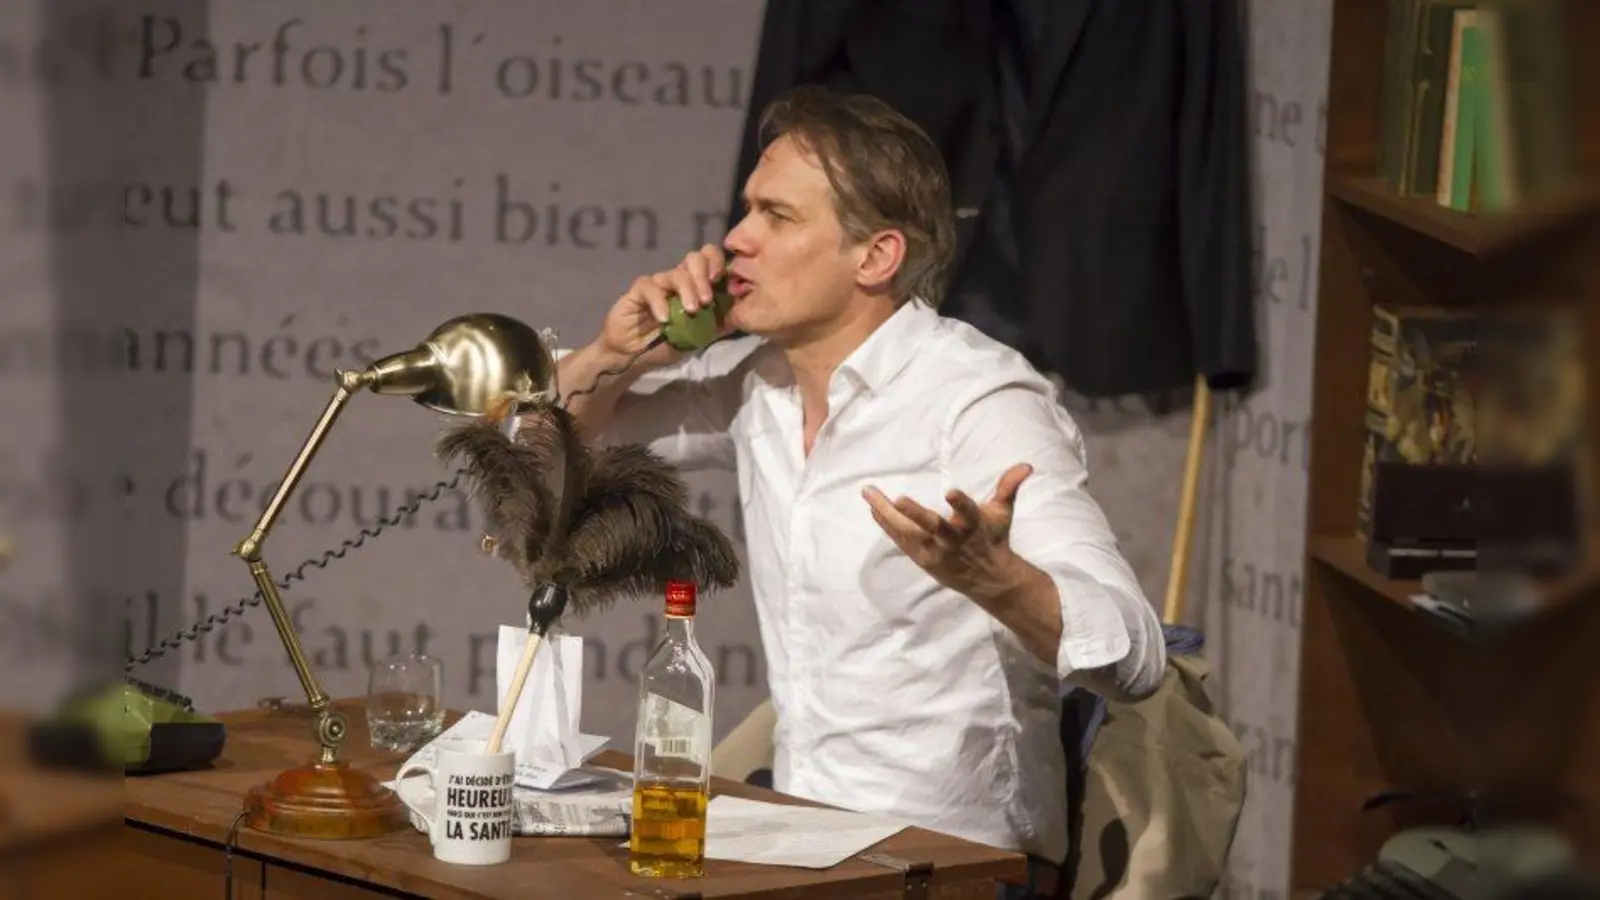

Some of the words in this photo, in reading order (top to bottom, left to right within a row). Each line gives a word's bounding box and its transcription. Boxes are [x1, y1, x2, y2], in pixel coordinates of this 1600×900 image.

[138, 14, 410, 93] Parfois
[268, 178, 463, 242] aussi
[495, 172, 658, 250] bien
[446, 820, 464, 840] LA
